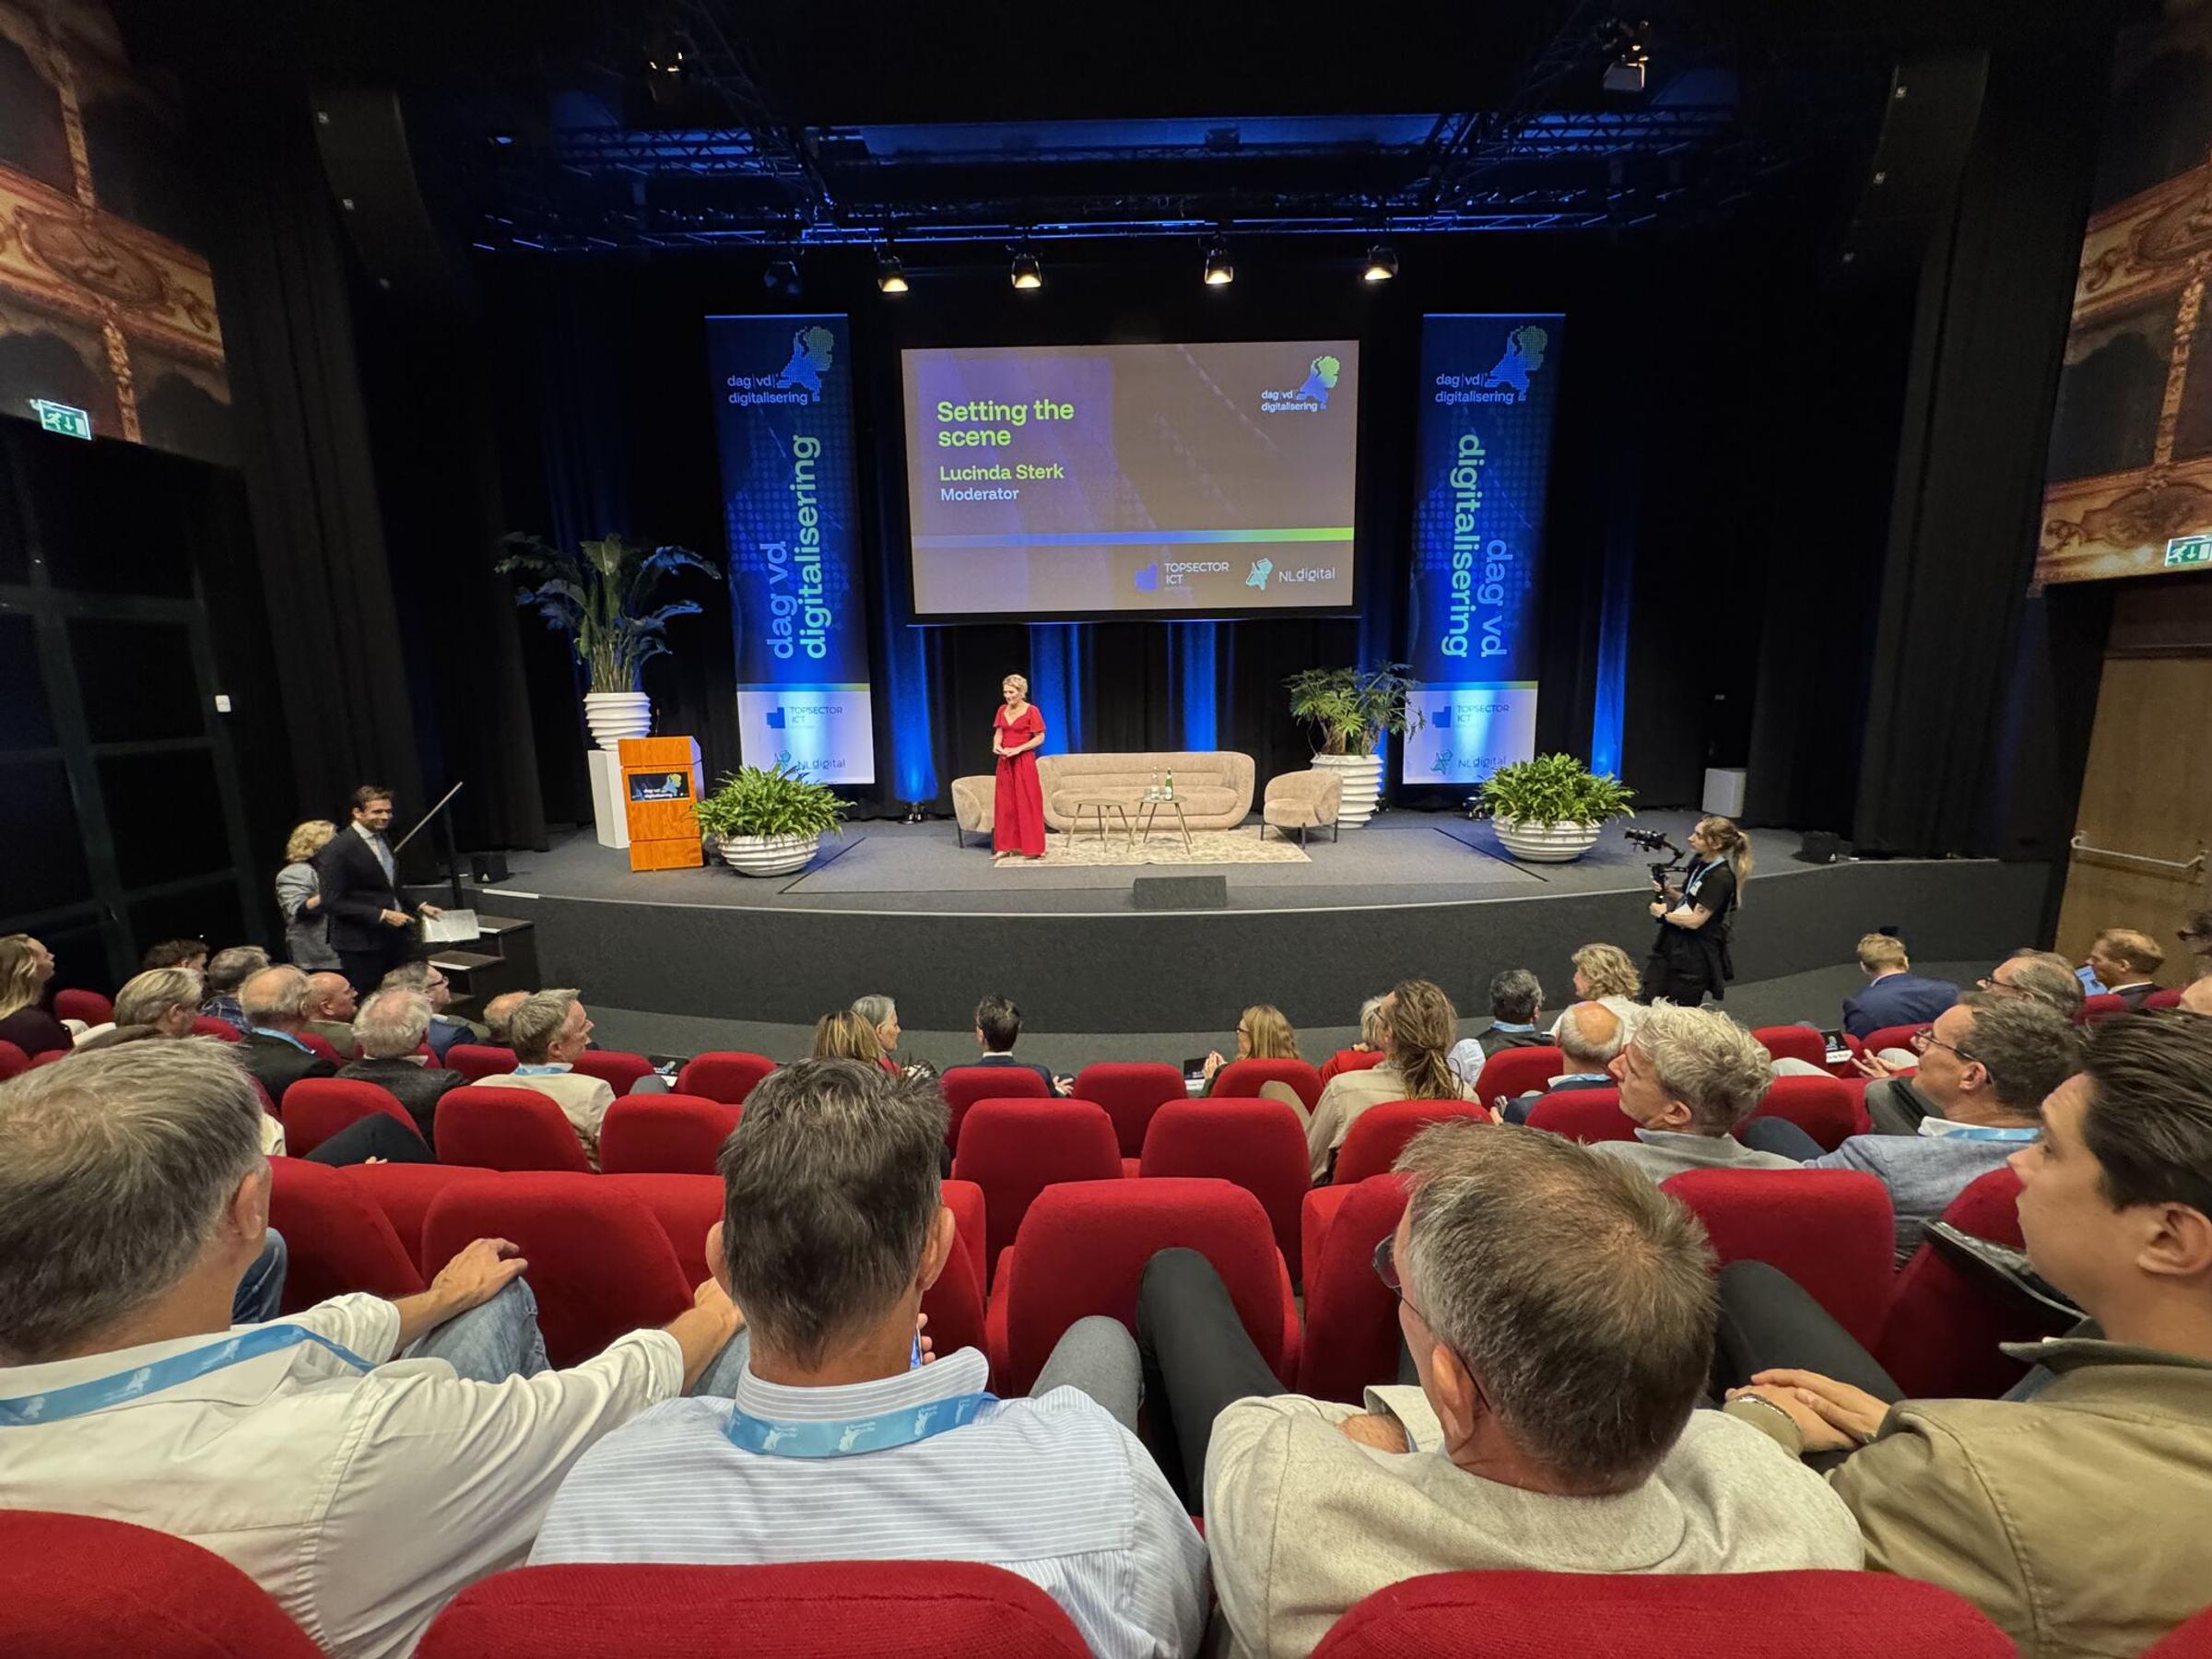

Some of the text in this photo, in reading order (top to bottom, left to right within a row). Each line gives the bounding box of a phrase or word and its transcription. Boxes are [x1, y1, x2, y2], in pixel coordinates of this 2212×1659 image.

[727, 374, 751, 390] dag
[1436, 373, 1460, 388] dag
[728, 392, 808, 406] digitalisering
[1435, 391, 1515, 406] digitalisering
[936, 399, 1075, 426] Setting the
[1261, 402, 1318, 413] digitalisering
[938, 429, 1012, 447] scene
[940, 464, 1065, 481] Lucinda Sterk
[940, 488, 1019, 501] Moderator
[790, 434, 832, 659] digitalisering
[1441, 434, 1486, 658] digitalisering
[1164, 561, 1230, 573] TOPSECTOR
[1165, 574, 1183, 585] ICT
[759, 541, 798, 659] dag vd
[1477, 539, 1513, 658] dag vd
[790, 706, 842, 715] TOPSECTOR
[1457, 704, 1510, 713] TOPSECTOR
[792, 715, 806, 724] ICT
[1457, 714, 1471, 723] ICT
